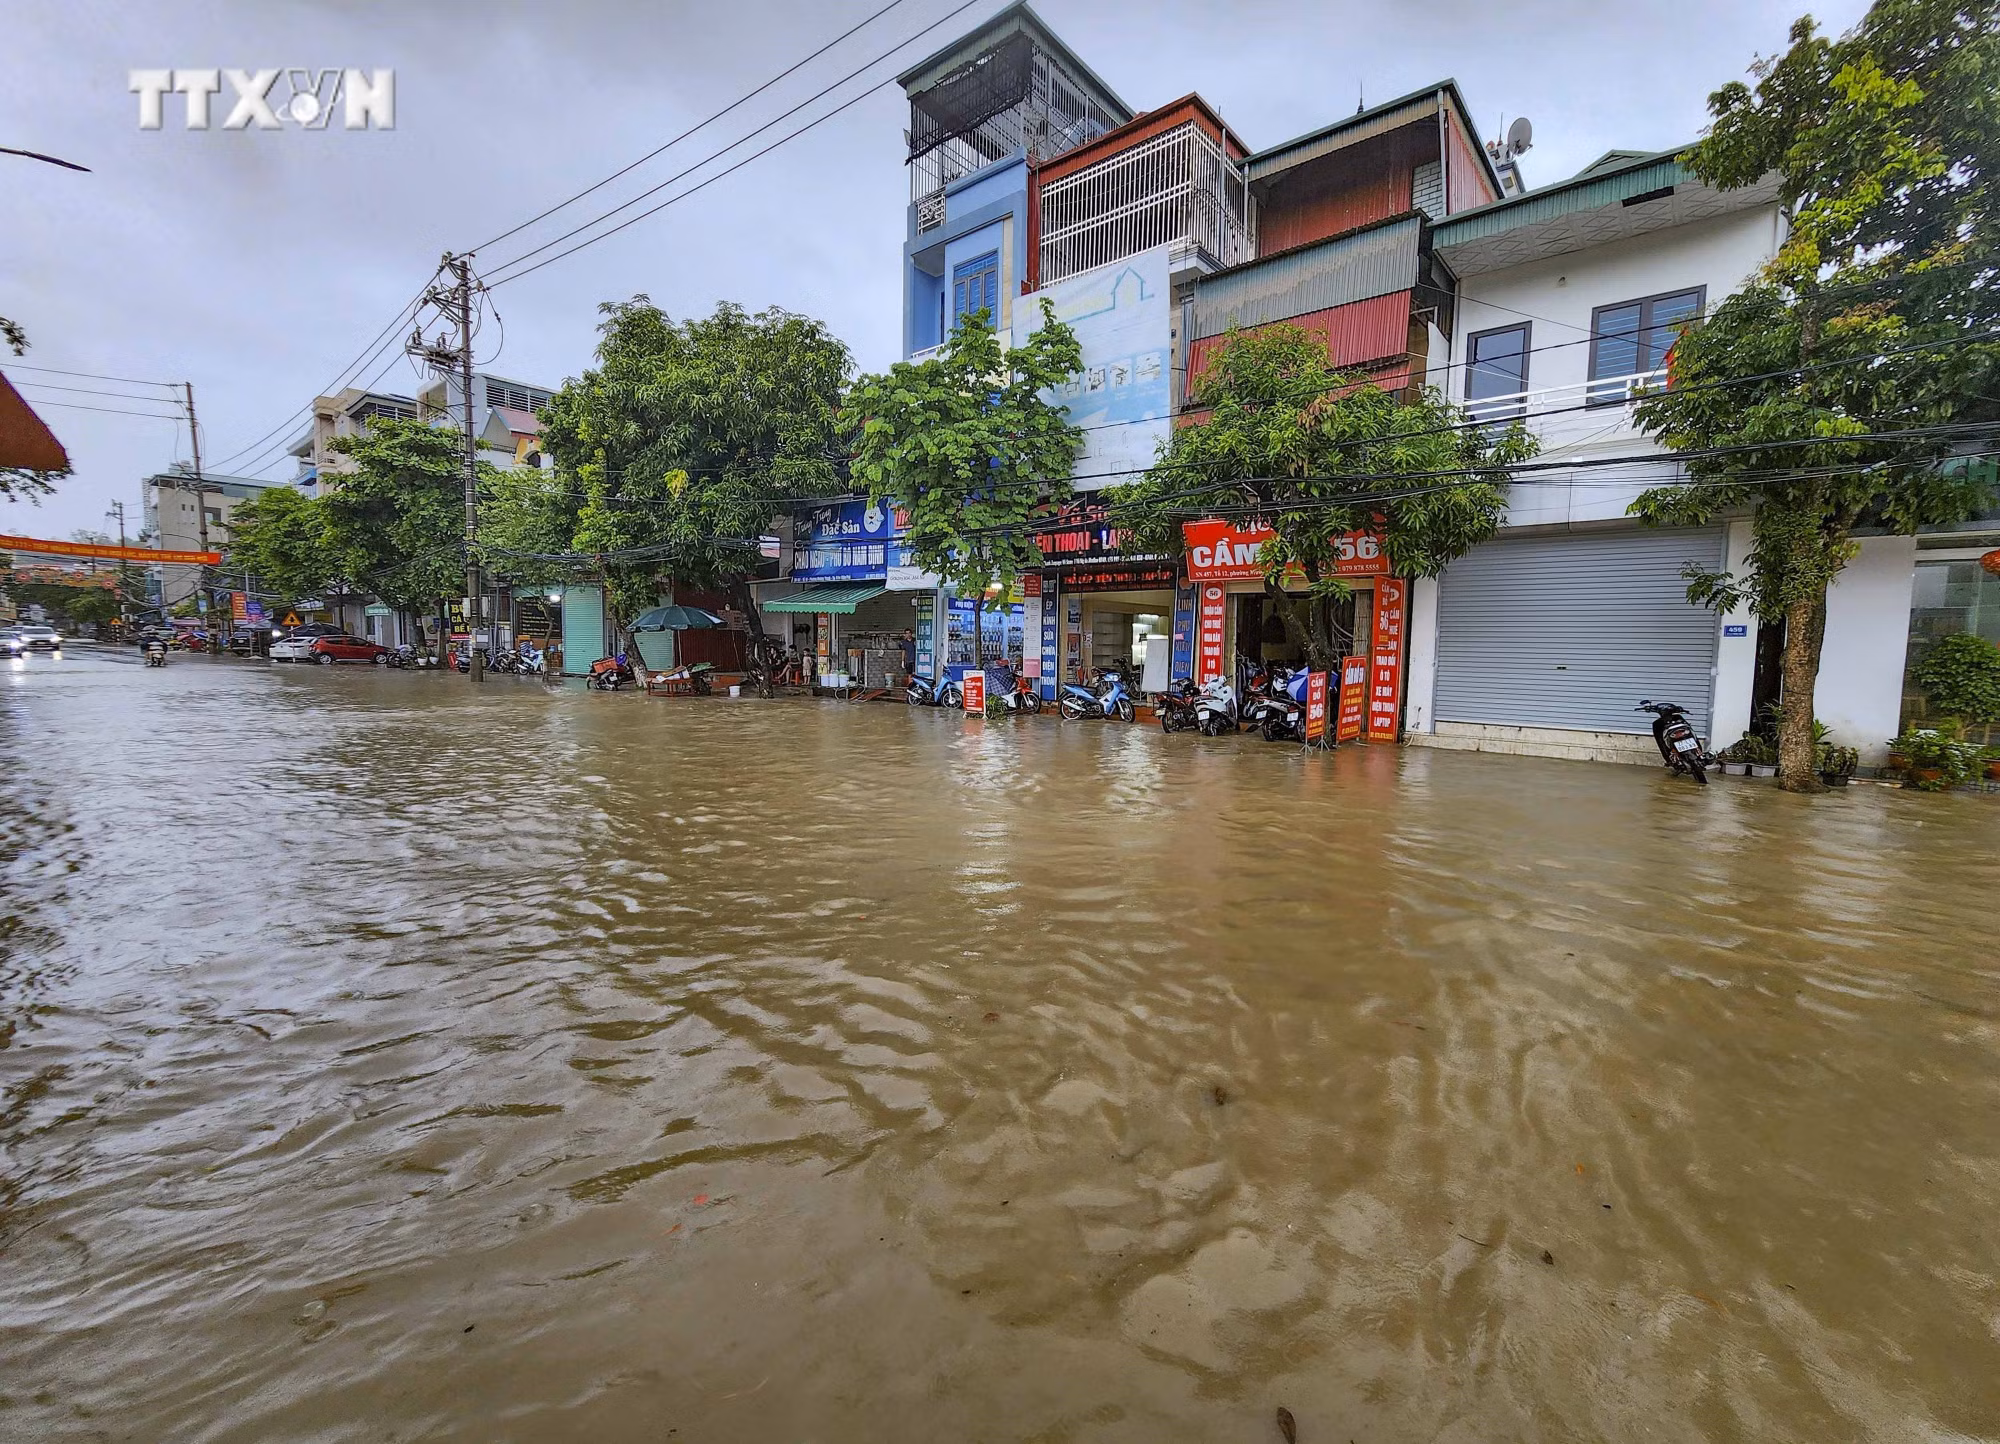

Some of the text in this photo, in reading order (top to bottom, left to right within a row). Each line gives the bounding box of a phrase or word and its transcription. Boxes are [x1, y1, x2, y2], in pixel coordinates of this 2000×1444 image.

[843, 520, 860, 534] Sản
[1054, 532, 1091, 555] THOẠI
[1193, 538, 1262, 568] CẦM
[1335, 537, 1379, 560] 56
[1043, 614, 1056, 626] KÍNH
[1310, 704, 1323, 720] 56
